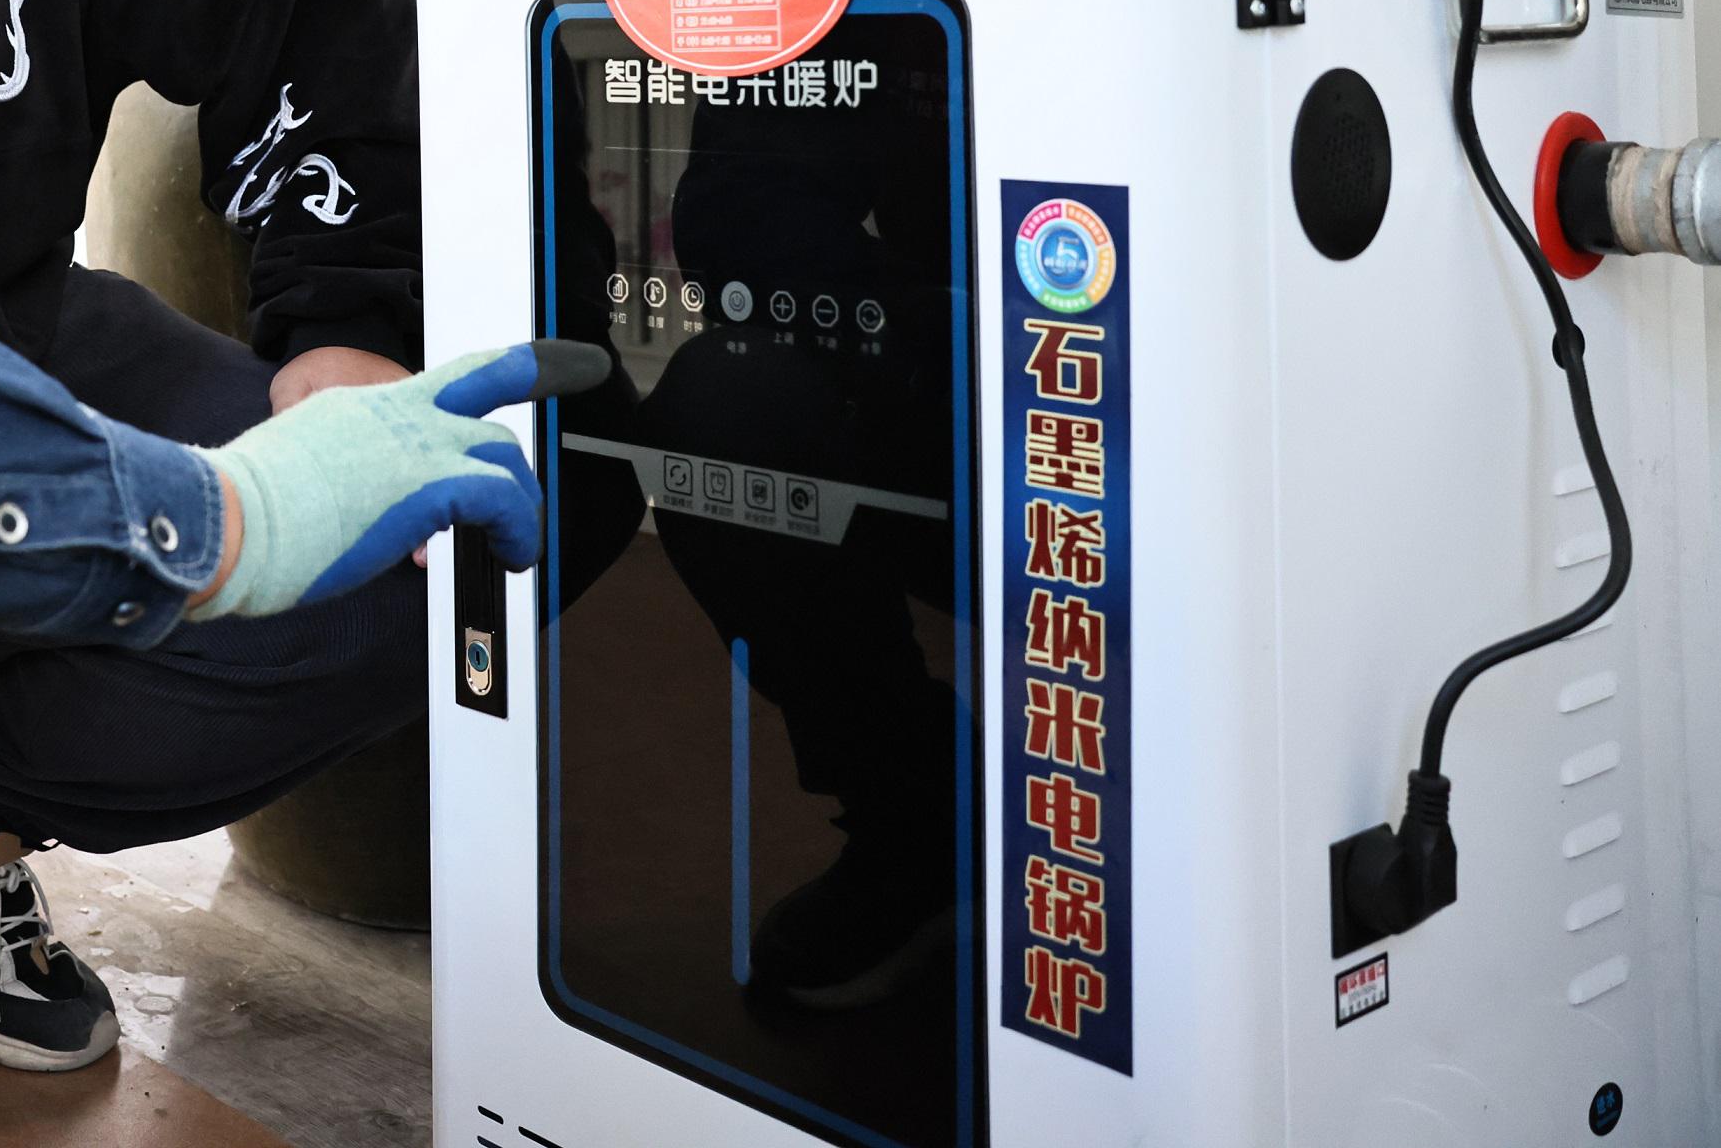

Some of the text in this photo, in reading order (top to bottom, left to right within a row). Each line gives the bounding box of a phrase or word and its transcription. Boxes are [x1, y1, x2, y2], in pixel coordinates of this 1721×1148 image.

[1023, 318, 1107, 1039] 石墨烯纳米电锅炉
